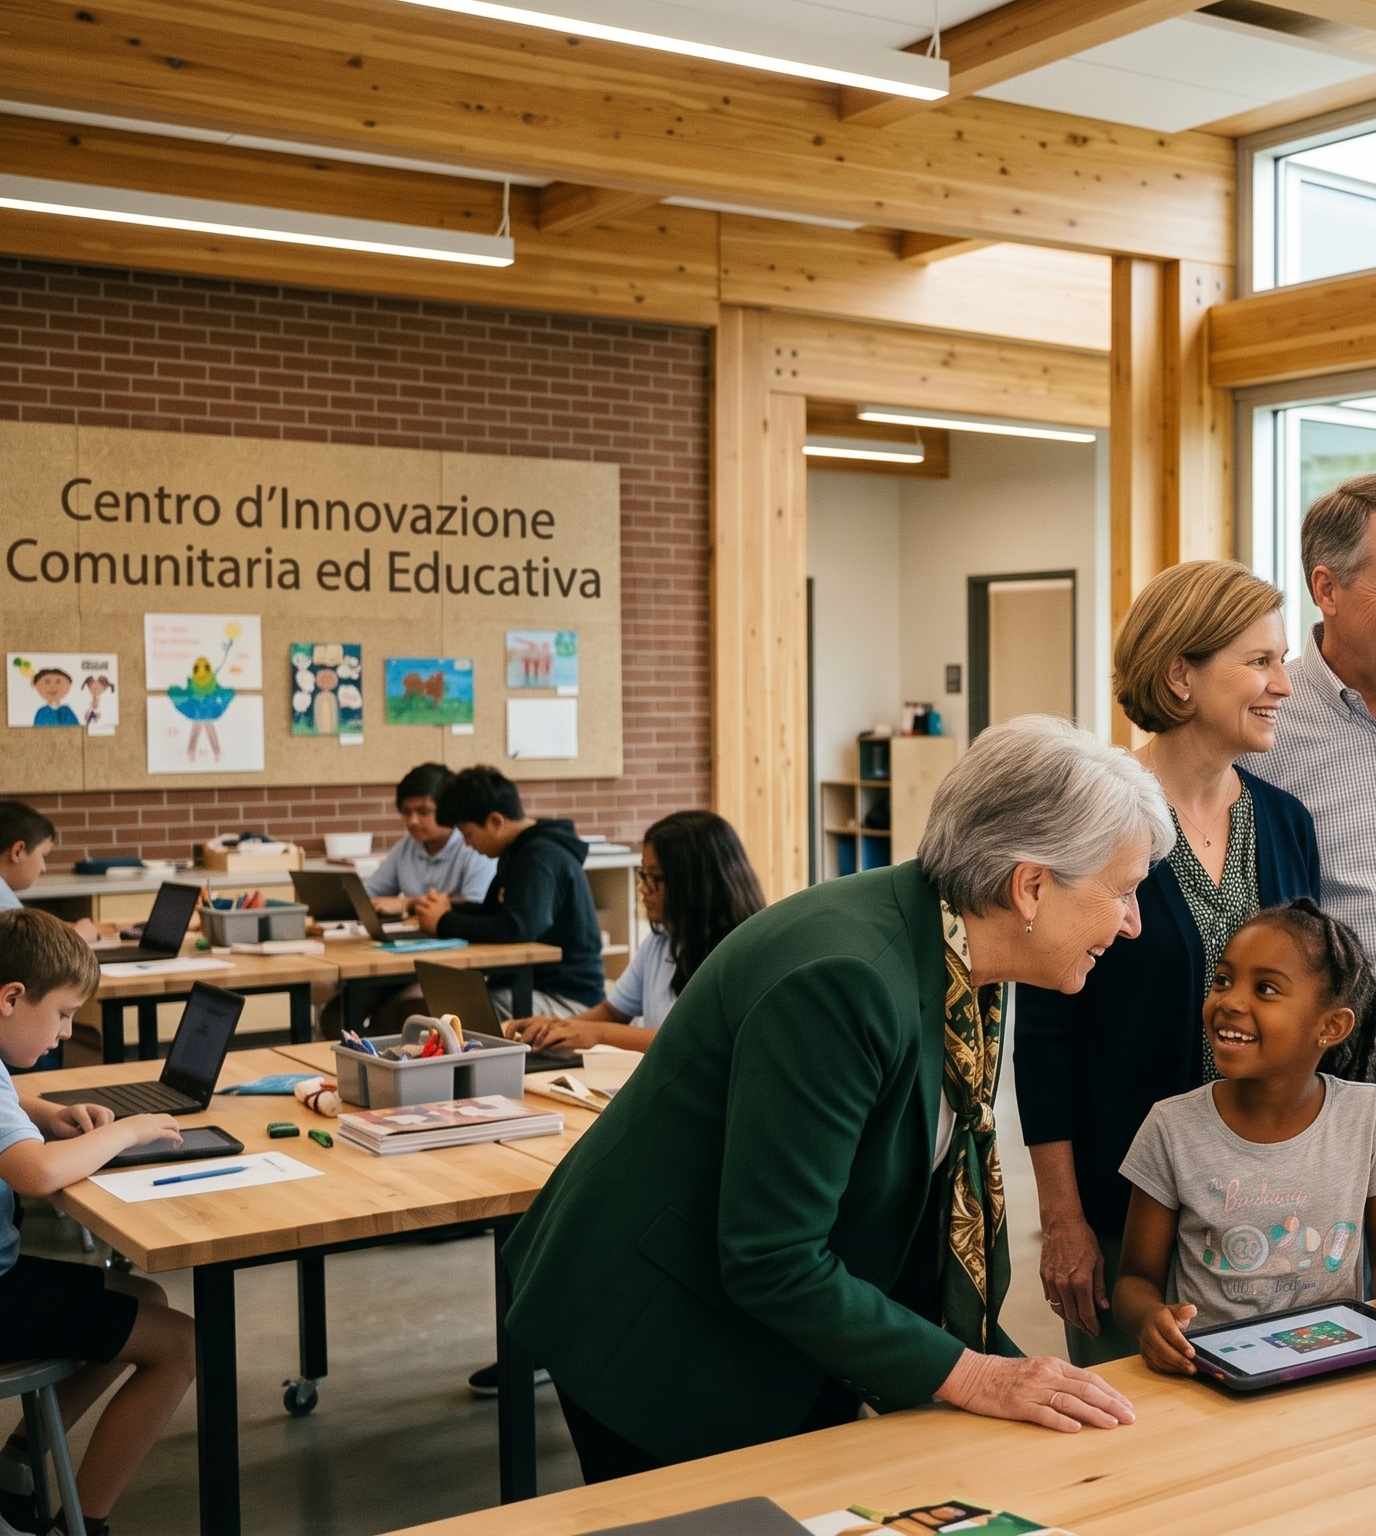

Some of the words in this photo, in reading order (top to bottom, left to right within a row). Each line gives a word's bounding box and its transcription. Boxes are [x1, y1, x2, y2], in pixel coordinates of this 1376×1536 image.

[59, 477, 222, 525] Centro
[234, 484, 557, 541] d'Innovazione
[6, 537, 303, 593] Comunitaria
[316, 547, 372, 593] ed
[388, 550, 602, 599] Educativa
